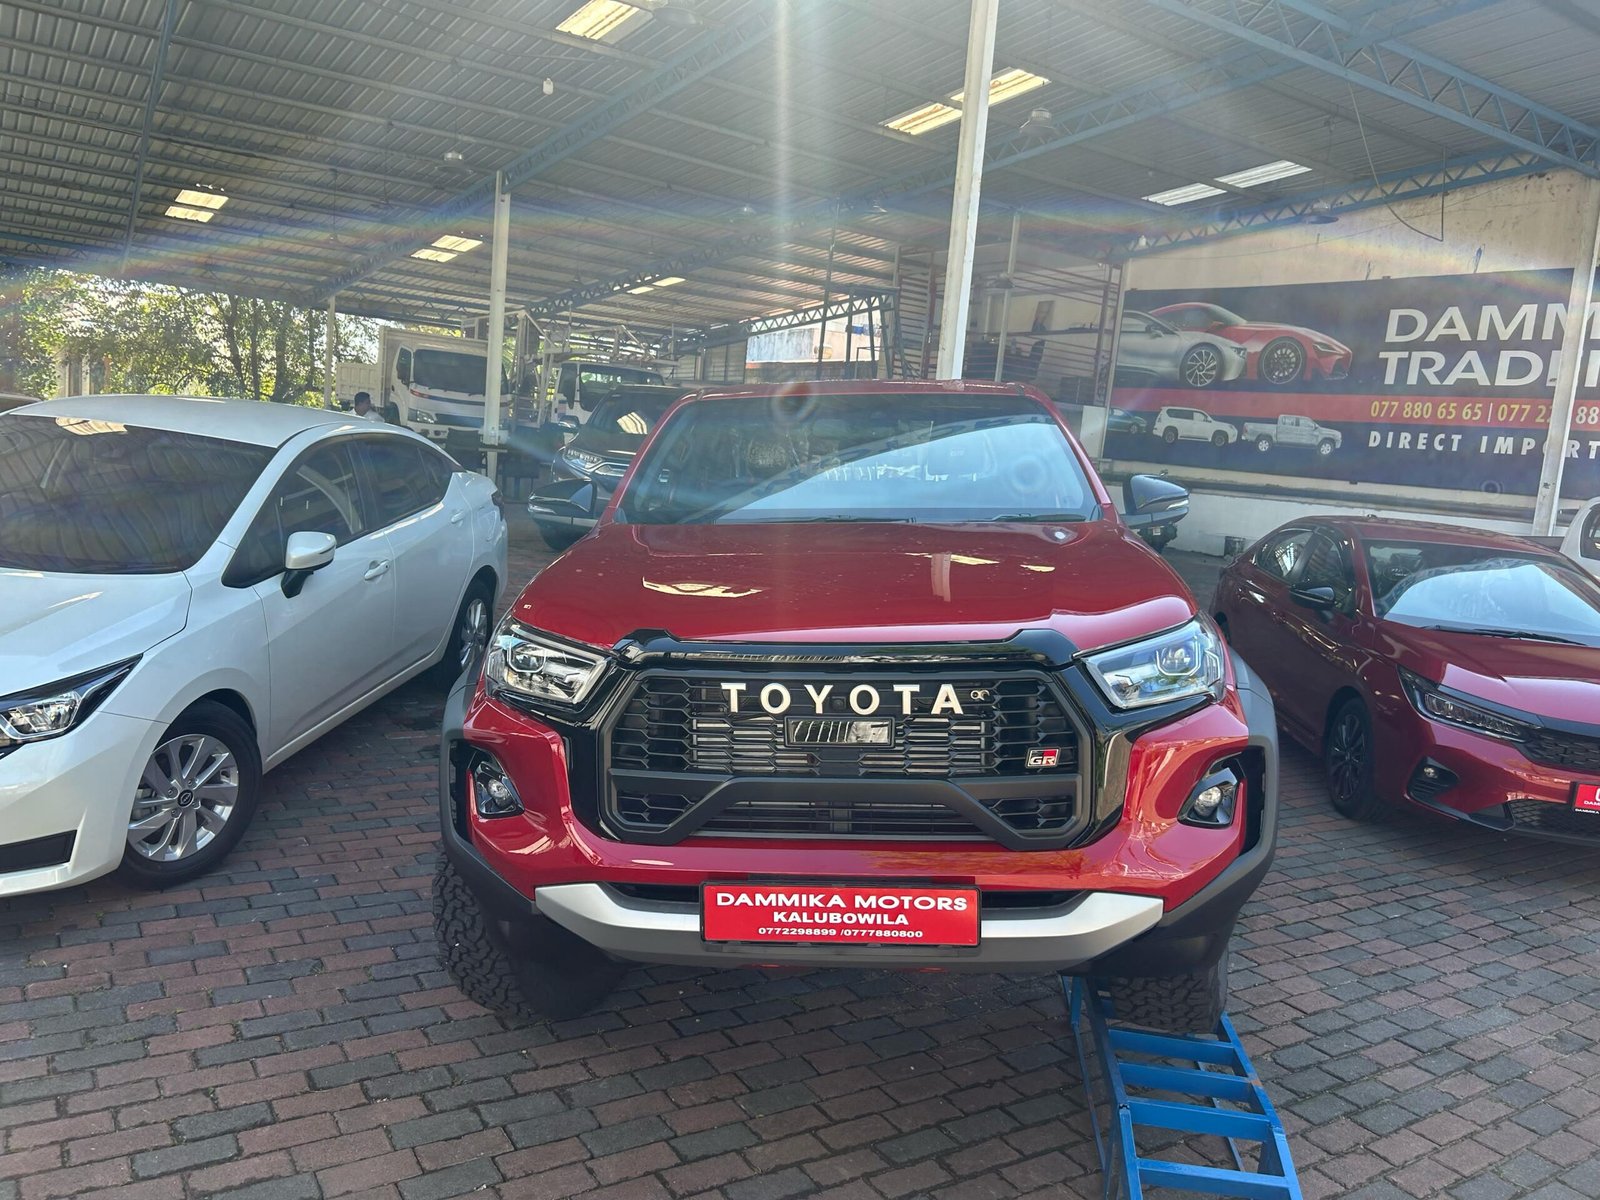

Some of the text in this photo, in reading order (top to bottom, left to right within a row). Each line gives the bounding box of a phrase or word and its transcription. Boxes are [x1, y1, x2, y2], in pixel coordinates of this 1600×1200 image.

[1370, 400, 1399, 418] 077
[1402, 401, 1432, 419] 880
[1436, 402, 1457, 420] 65
[1462, 403, 1483, 421] 65
[1497, 404, 1531, 422] 077
[1368, 431, 1600, 459] DIRECT IMPRT
[721, 682, 964, 716] TOYOTA
[716, 892, 968, 911] DAMMIKA MOTORS
[773, 911, 909, 926] KALUBOWILA
[758, 927, 924, 939] 0772298899 /0777880800
